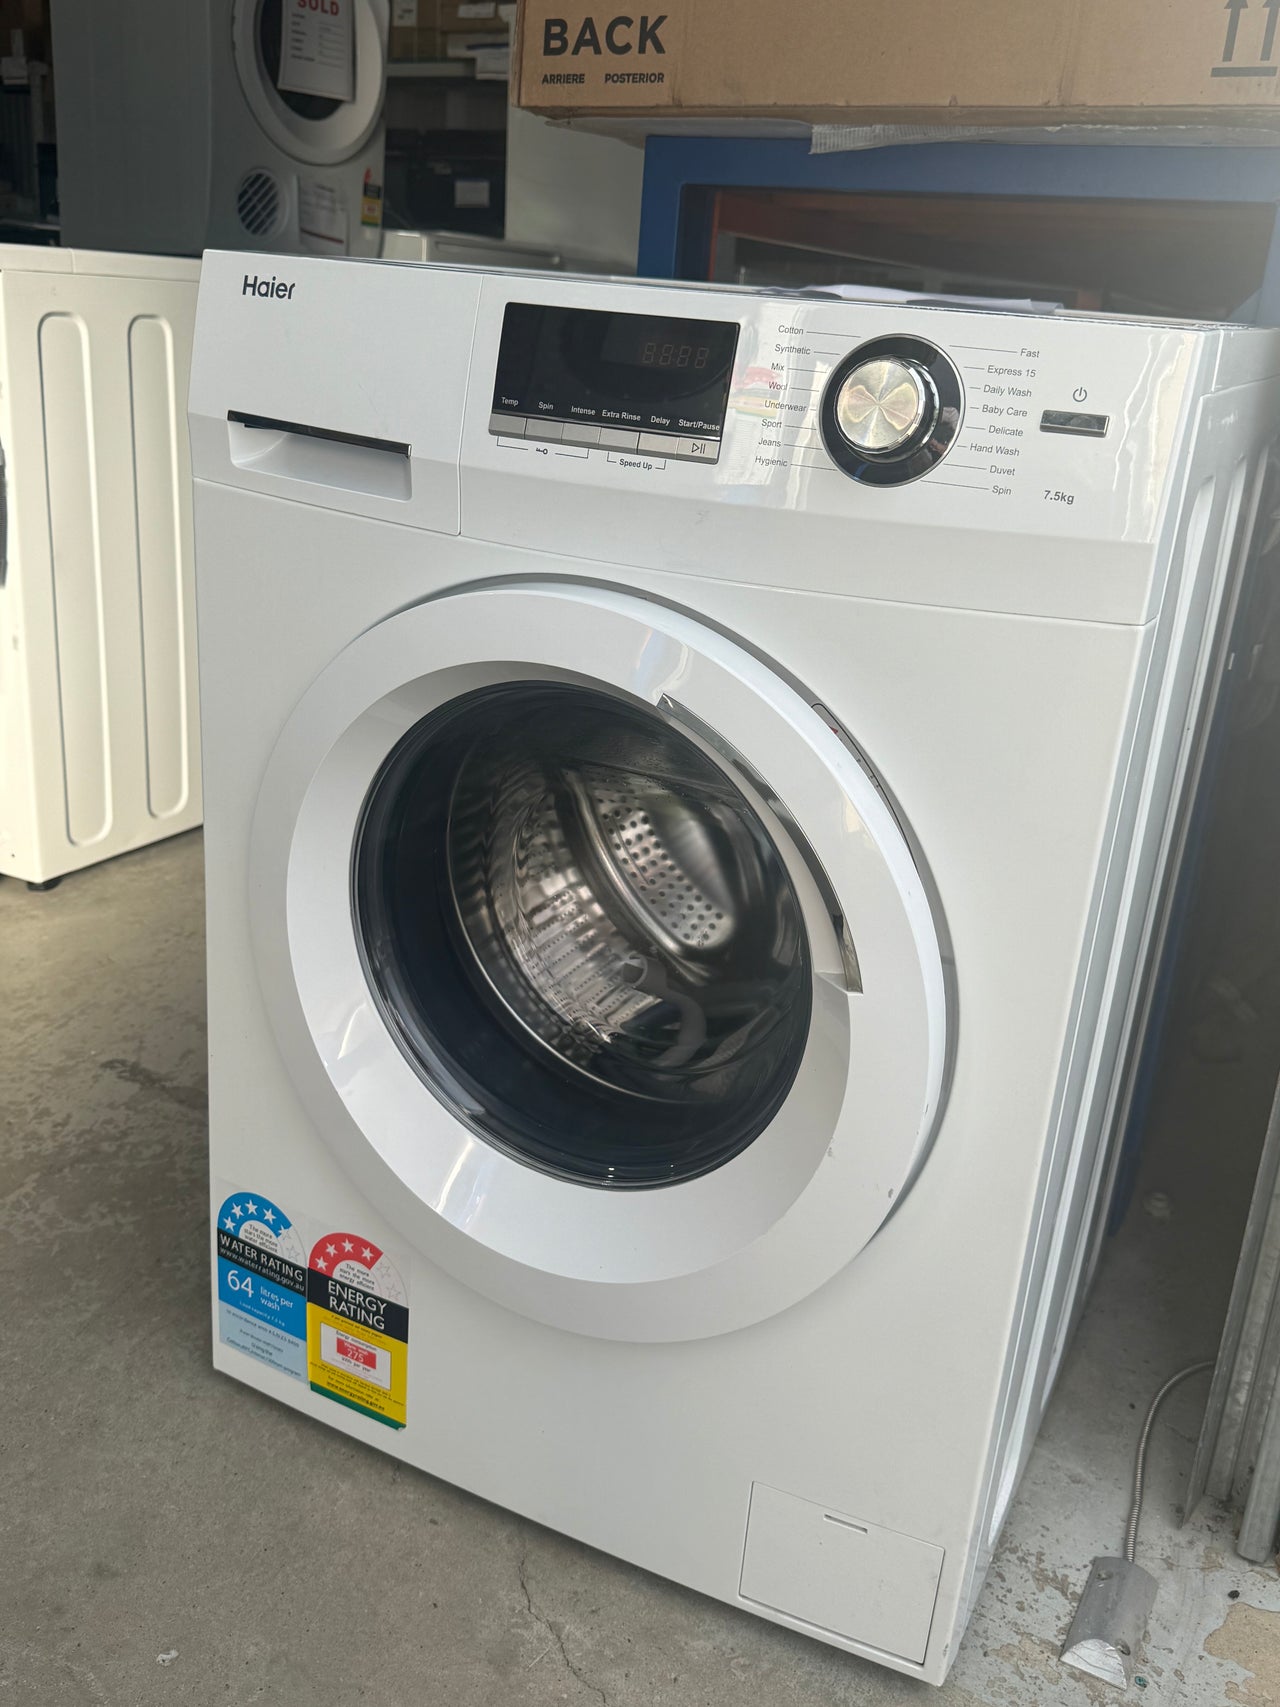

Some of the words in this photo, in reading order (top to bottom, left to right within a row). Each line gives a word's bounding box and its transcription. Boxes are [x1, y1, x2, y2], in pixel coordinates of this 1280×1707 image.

[297, 0, 340, 16] SOLD
[543, 15, 668, 56] BACK
[542, 73, 586, 84] ARRIERE
[604, 72, 665, 84] POSTERIOR
[242, 274, 296, 300] Haier
[778, 325, 804, 335] Cotton
[774, 344, 810, 355] Synthetic
[1020, 348, 1040, 358] Fast
[770, 362, 784, 371] Mix
[987, 365, 1022, 376] Express
[1025, 369, 1036, 378] 15
[768, 381, 788, 390] Wool
[983, 384, 1006, 396] Daily
[1008, 386, 1032, 397] Wash
[502, 396, 518, 407] Temp
[538, 402, 554, 410] Spin
[764, 400, 806, 412] Underwear
[571, 406, 596, 416] Intense
[602, 410, 620, 419] Extra
[620, 412, 641, 421] Rinse
[982, 404, 1004, 416] Baby
[1006, 406, 1028, 417] Care
[650, 415, 670, 426] Delay
[678, 419, 720, 431] Start/Pause
[762, 418, 782, 428] Sport
[988, 424, 1024, 436] Delicate
[758, 437, 781, 448] Jeans
[970, 442, 993, 454] Hand
[995, 445, 1020, 456] Wash
[619, 458, 642, 470] Speed
[642, 460, 652, 470] Up
[754, 456, 788, 467] Hygienic
[990, 464, 1016, 476] Duvet
[992, 485, 1012, 496] Spin
[1044, 490, 1074, 505] 7.5kg
[220, 1234, 258, 1260] WATER
[260, 1253, 303, 1282] RATING
[227, 1269, 254, 1298] 64
[260, 1286, 279, 1302] litres
[280, 1297, 294, 1308] per
[328, 1280, 387, 1315] ENERGY
[260, 1298, 280, 1312] wash
[329, 1296, 385, 1330] RATING
[347, 1348, 364, 1362] 275
